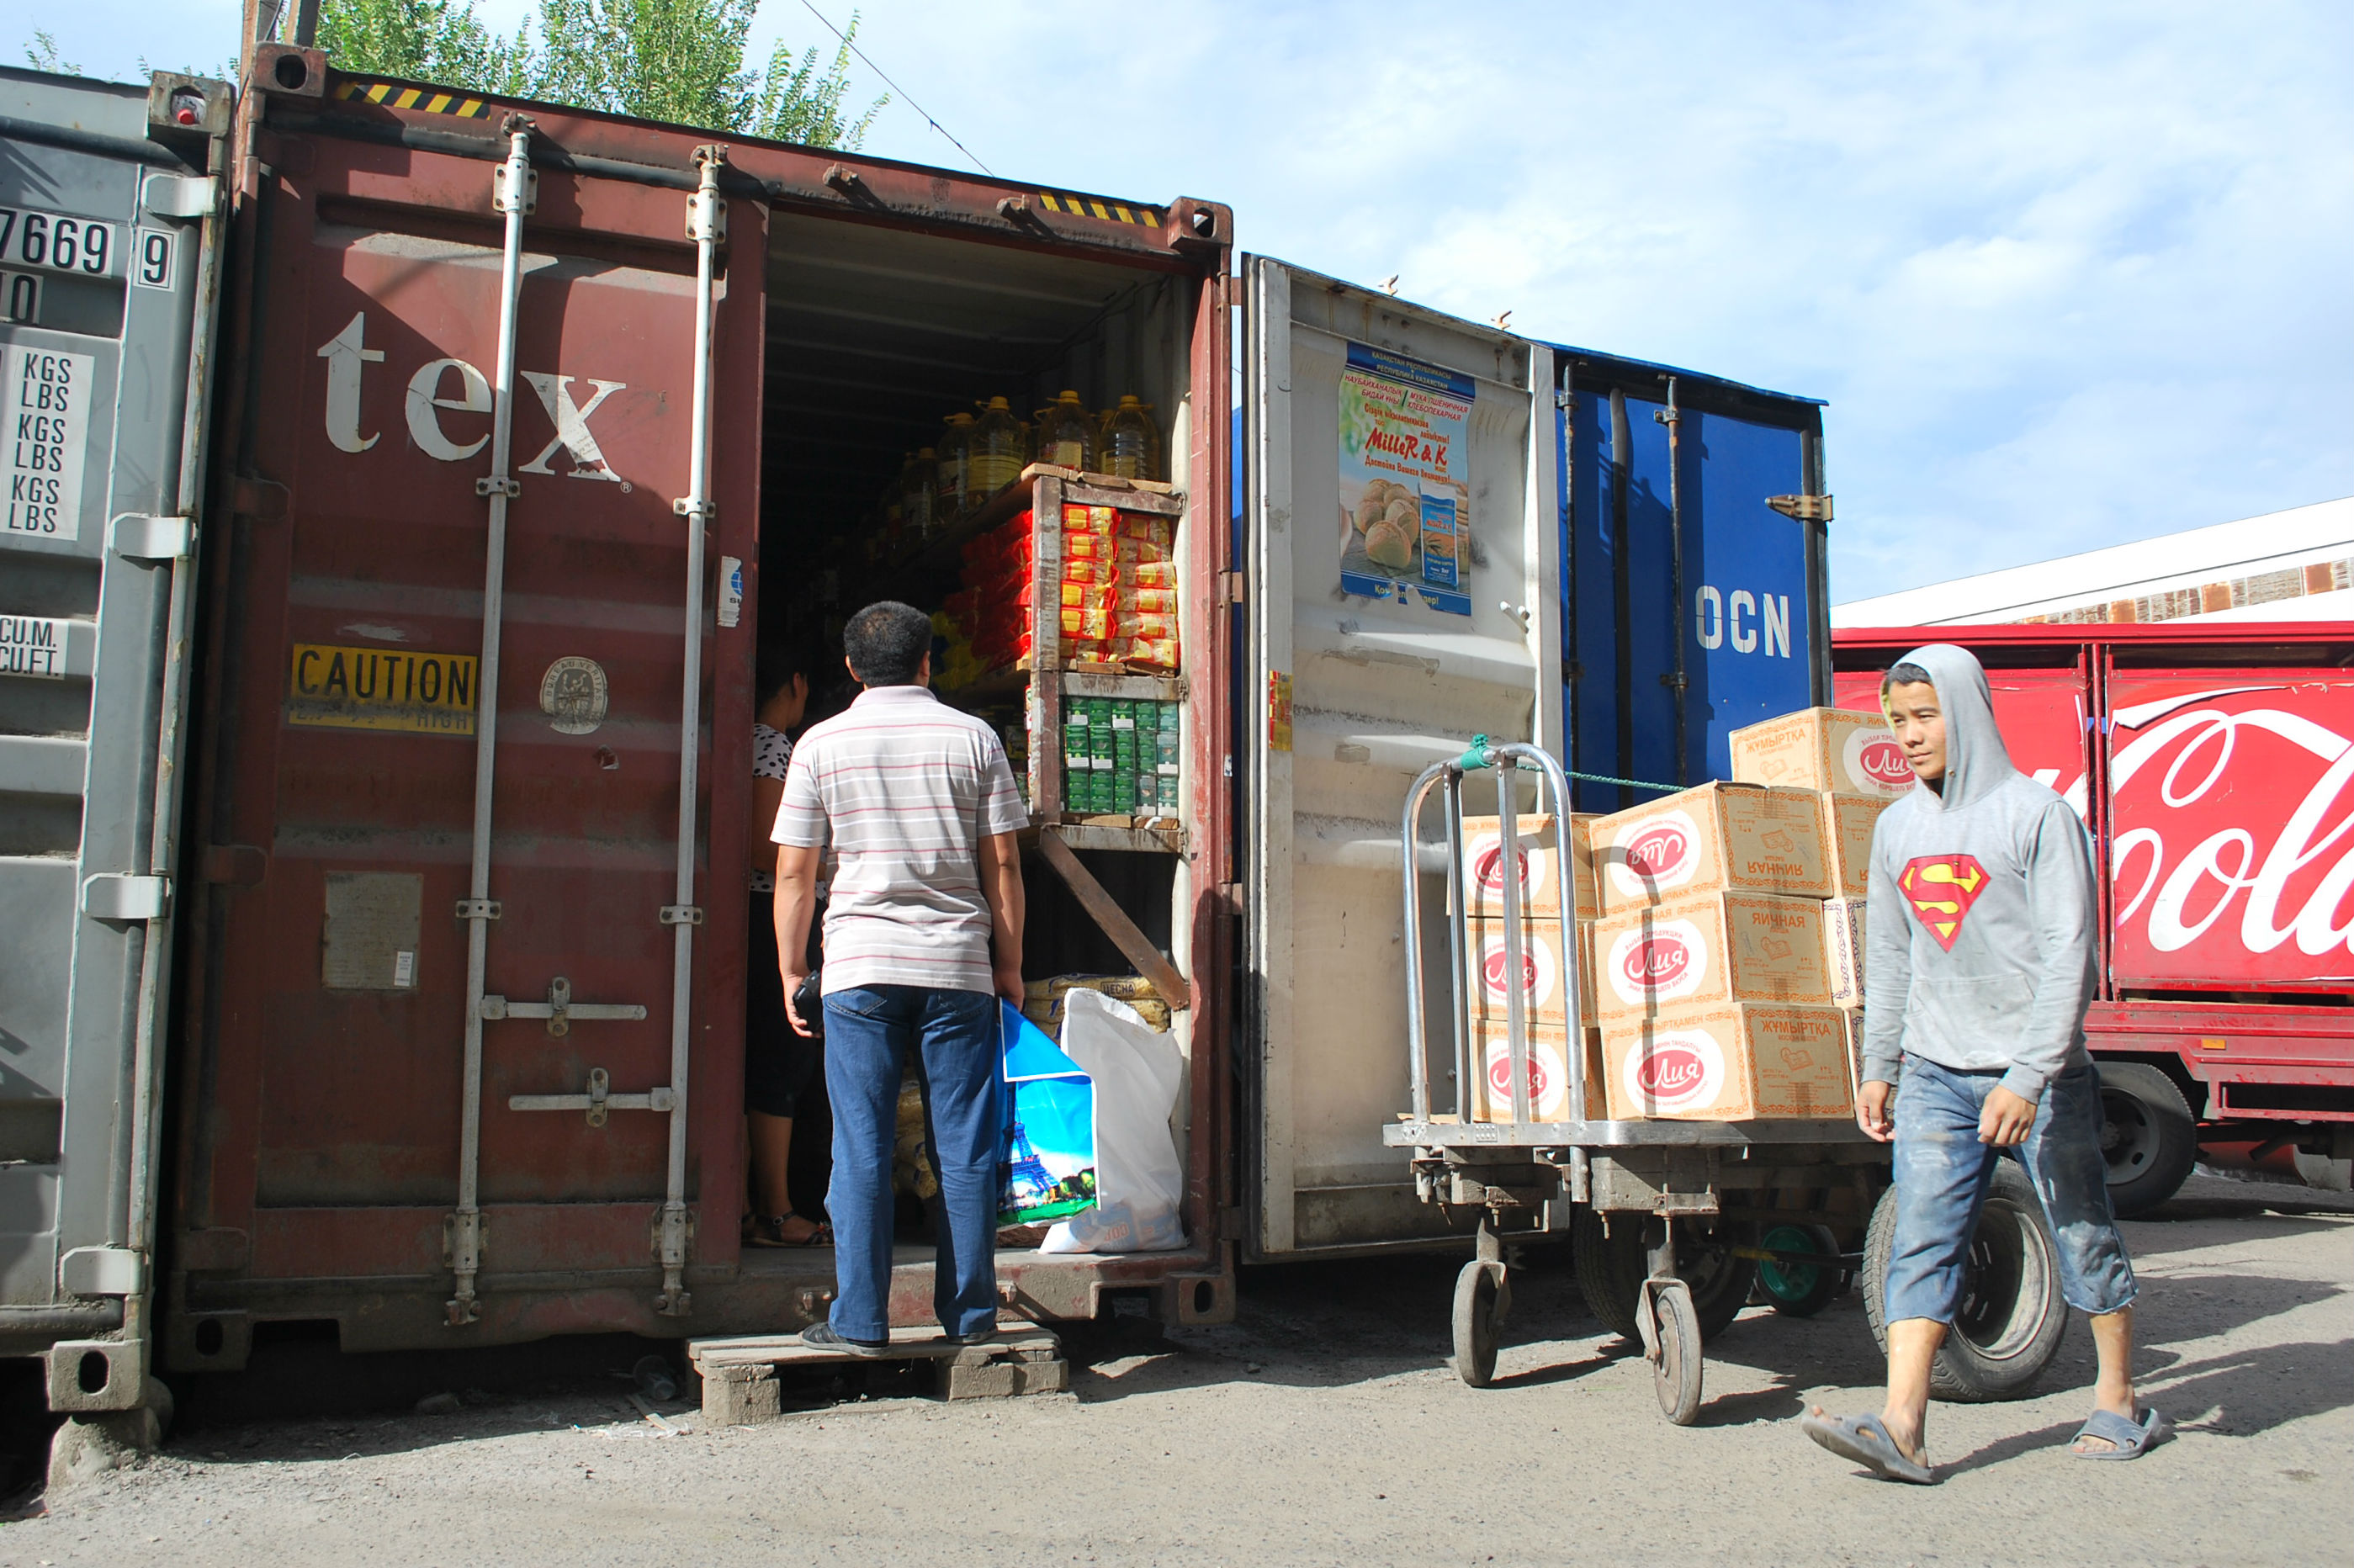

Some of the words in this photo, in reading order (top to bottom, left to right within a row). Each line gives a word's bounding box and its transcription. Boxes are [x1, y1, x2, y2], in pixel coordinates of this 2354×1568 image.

[0, 210, 109, 274] 7669
[144, 234, 169, 284] 9
[24, 352, 72, 384] KGS
[21, 380, 69, 412] LBS
[316, 311, 626, 483] tex
[1407, 400, 1462, 421] ХЛЕБОПЕКАРНАЯ
[1429, 397, 1469, 413] ПШЕНИЧНАЯ
[18, 413, 66, 444] KGS
[15, 442, 63, 473] LBS
[1365, 426, 1419, 460] MilleR
[1434, 443, 1447, 466] K
[12, 474, 60, 505] KGS
[8, 502, 57, 533] LBS
[1695, 585, 1790, 659] OCN
[298, 649, 470, 706] CAUTION
[545, 660, 575, 697] BUREAU
[579, 660, 604, 701] VERITAS
[1864, 749, 1912, 776] Ли
[1629, 834, 1683, 867] Лия
[1747, 861, 1804, 877] ЯИЧНАЯ
[1632, 908, 1673, 925] ЯИЧНАЯ
[1752, 913, 1805, 929] ЯИЧНАЯ
[1625, 934, 1646, 951] ВЫБОР
[1646, 930, 1683, 940] ПРОДУКЦИИ
[1627, 946, 1686, 979] Лия
[1672, 972, 1689, 988] ВКУСА
[1761, 1020, 1832, 1037] ЖҰМЫРТҚА
[1641, 1057, 1700, 1089] Лия
